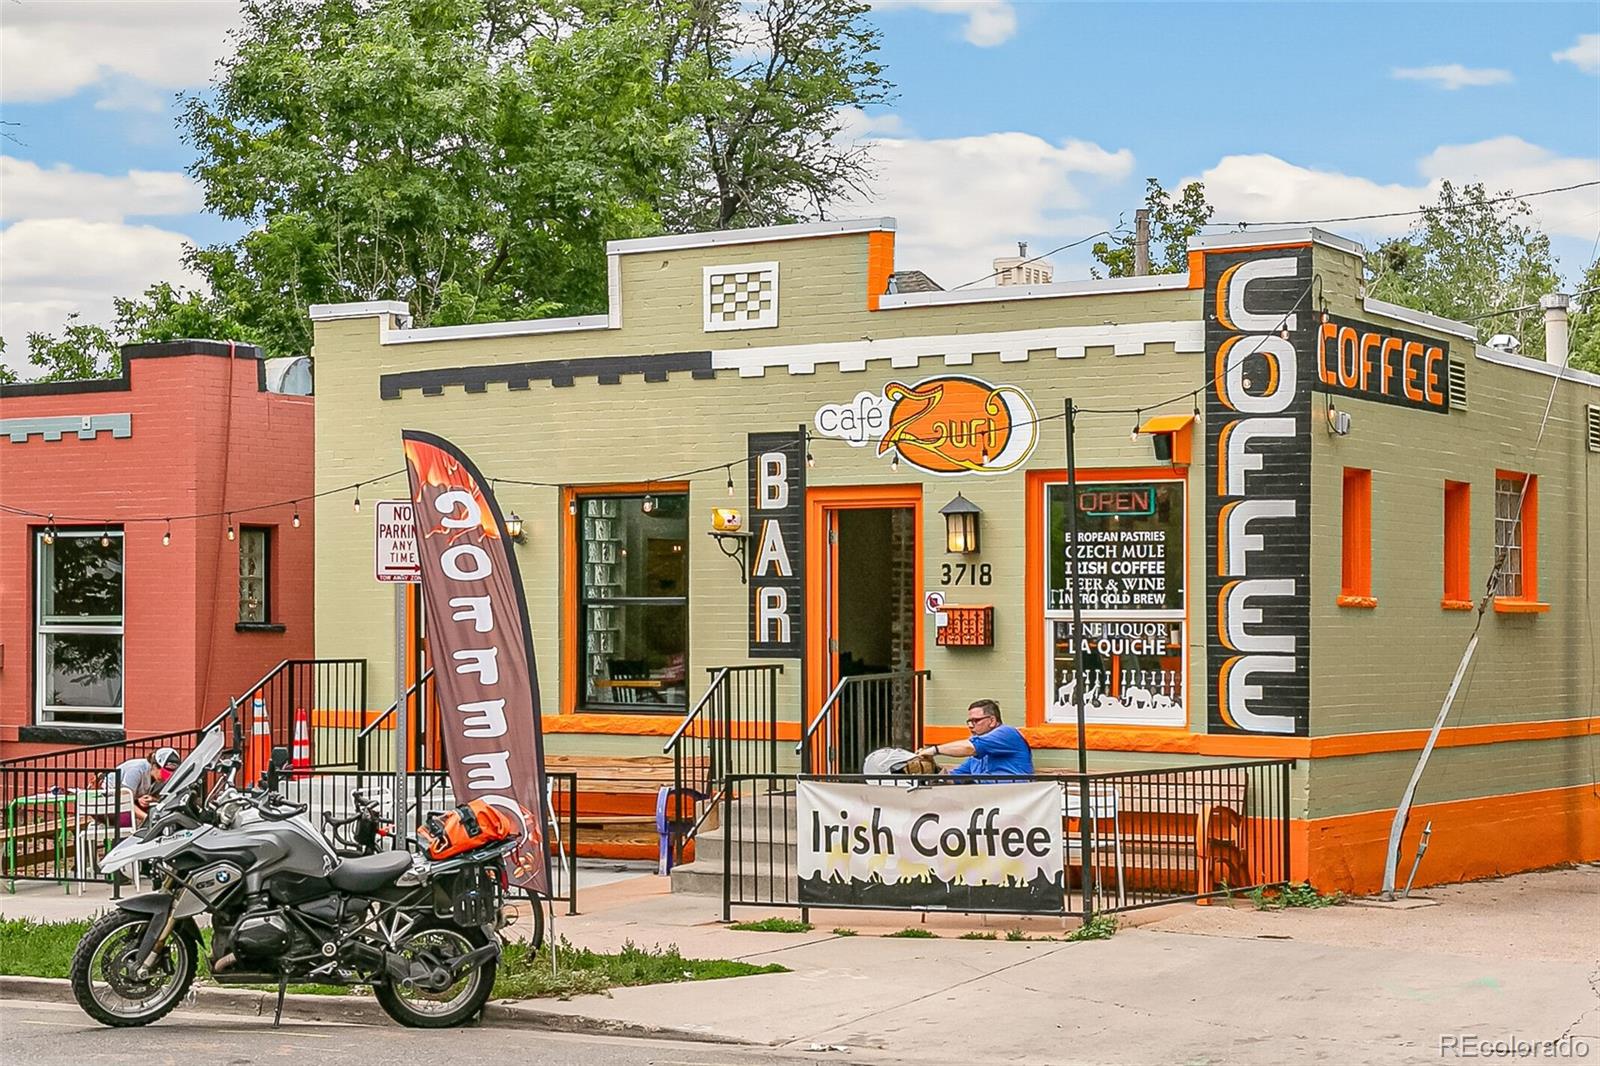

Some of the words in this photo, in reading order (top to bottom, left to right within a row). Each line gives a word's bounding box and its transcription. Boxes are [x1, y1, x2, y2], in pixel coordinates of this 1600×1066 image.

[1317, 323, 1443, 405] COFFEE
[820, 396, 882, 442] café
[878, 383, 1020, 468] Zuri
[1080, 491, 1148, 511] OPEN
[1215, 257, 1297, 733] COFFEE
[393, 506, 411, 521] NO
[379, 524, 417, 538] PARKIN
[1065, 532, 1118, 542] EROPEAN
[1120, 531, 1165, 542] PASTRIES
[392, 541, 413, 551] ANY
[753, 452, 793, 643] BAR
[1122, 545, 1165, 558] MULE
[390, 553, 415, 562] TIME
[941, 563, 992, 586] 3718
[1111, 562, 1165, 574] COFFEE
[1121, 578, 1165, 590] WINE
[1100, 593, 1131, 604] COLD
[1133, 594, 1166, 604] BREW
[1069, 623, 1102, 636] FNE
[1107, 623, 1167, 638] LIQUOR
[1097, 639, 1166, 656] QUICHE
[812, 807, 895, 854] Irish
[910, 807, 1051, 857] Coffee
